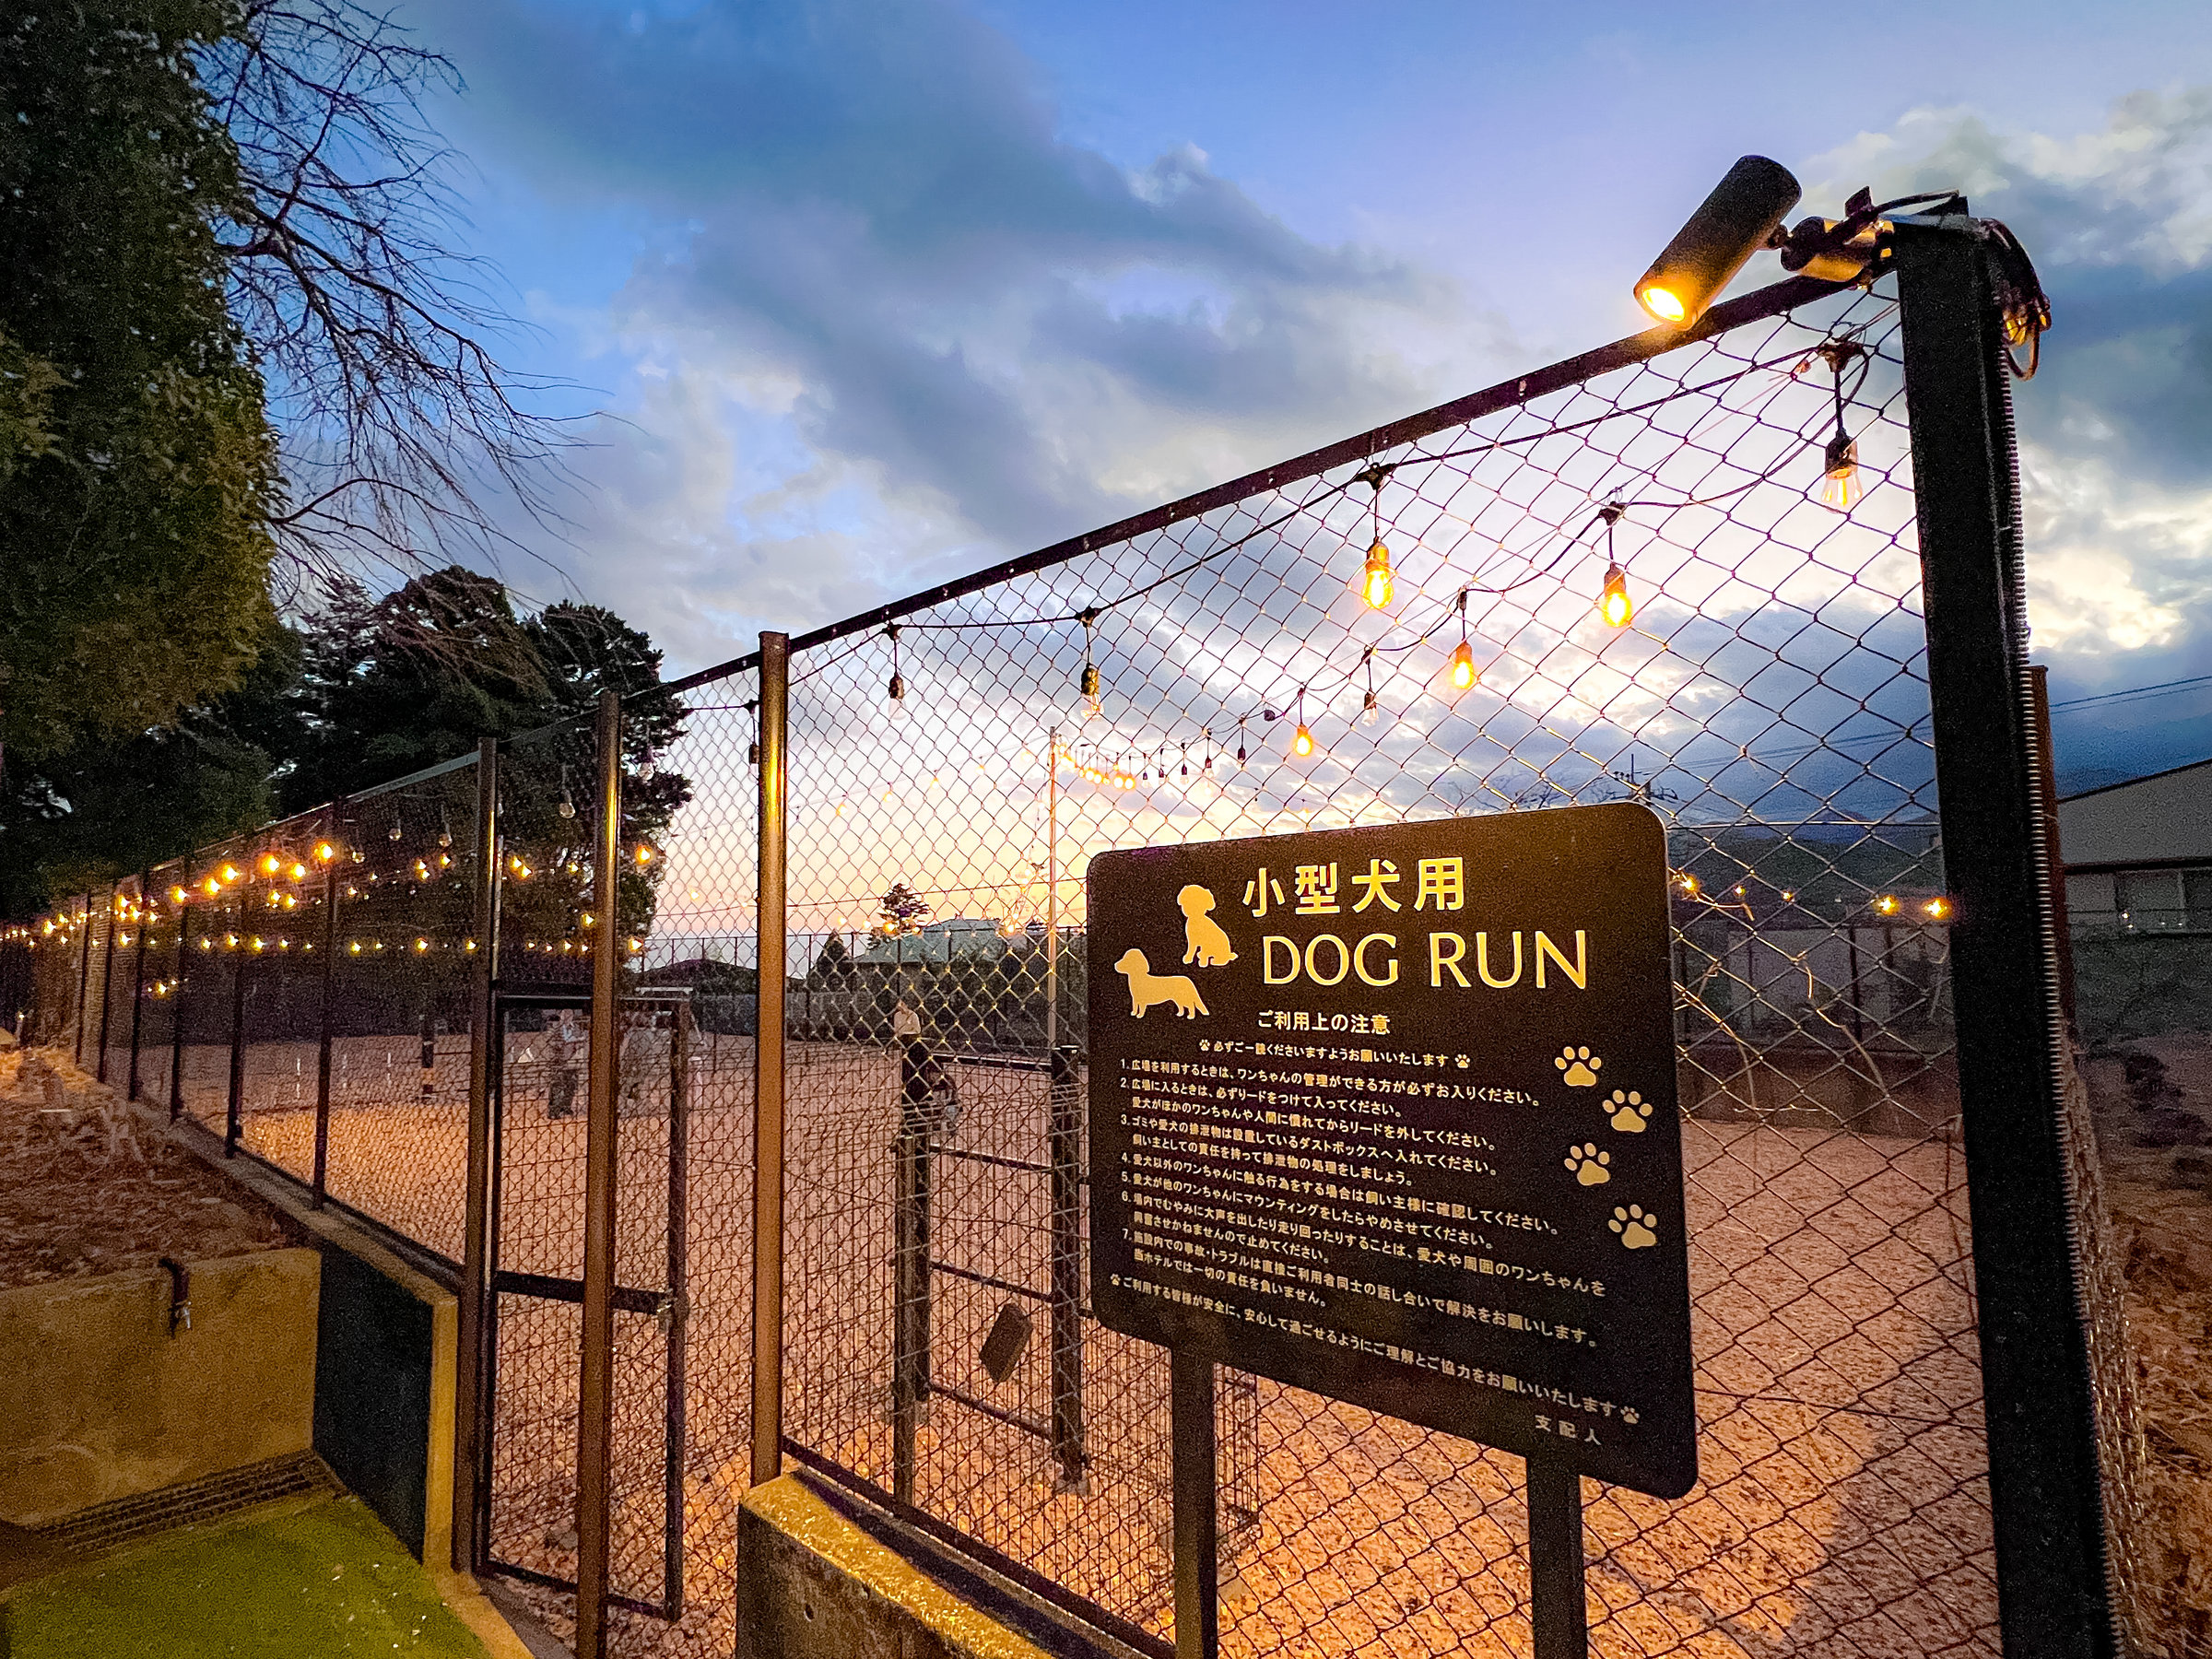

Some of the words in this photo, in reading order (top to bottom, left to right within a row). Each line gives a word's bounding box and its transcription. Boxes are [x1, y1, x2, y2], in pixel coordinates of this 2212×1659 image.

[1241, 856, 1465, 917] 小型犬用
[1263, 933, 1399, 987] DOG
[1430, 930, 1587, 990] RUN
[1258, 1011, 1390, 1036] ご利用上の注意
